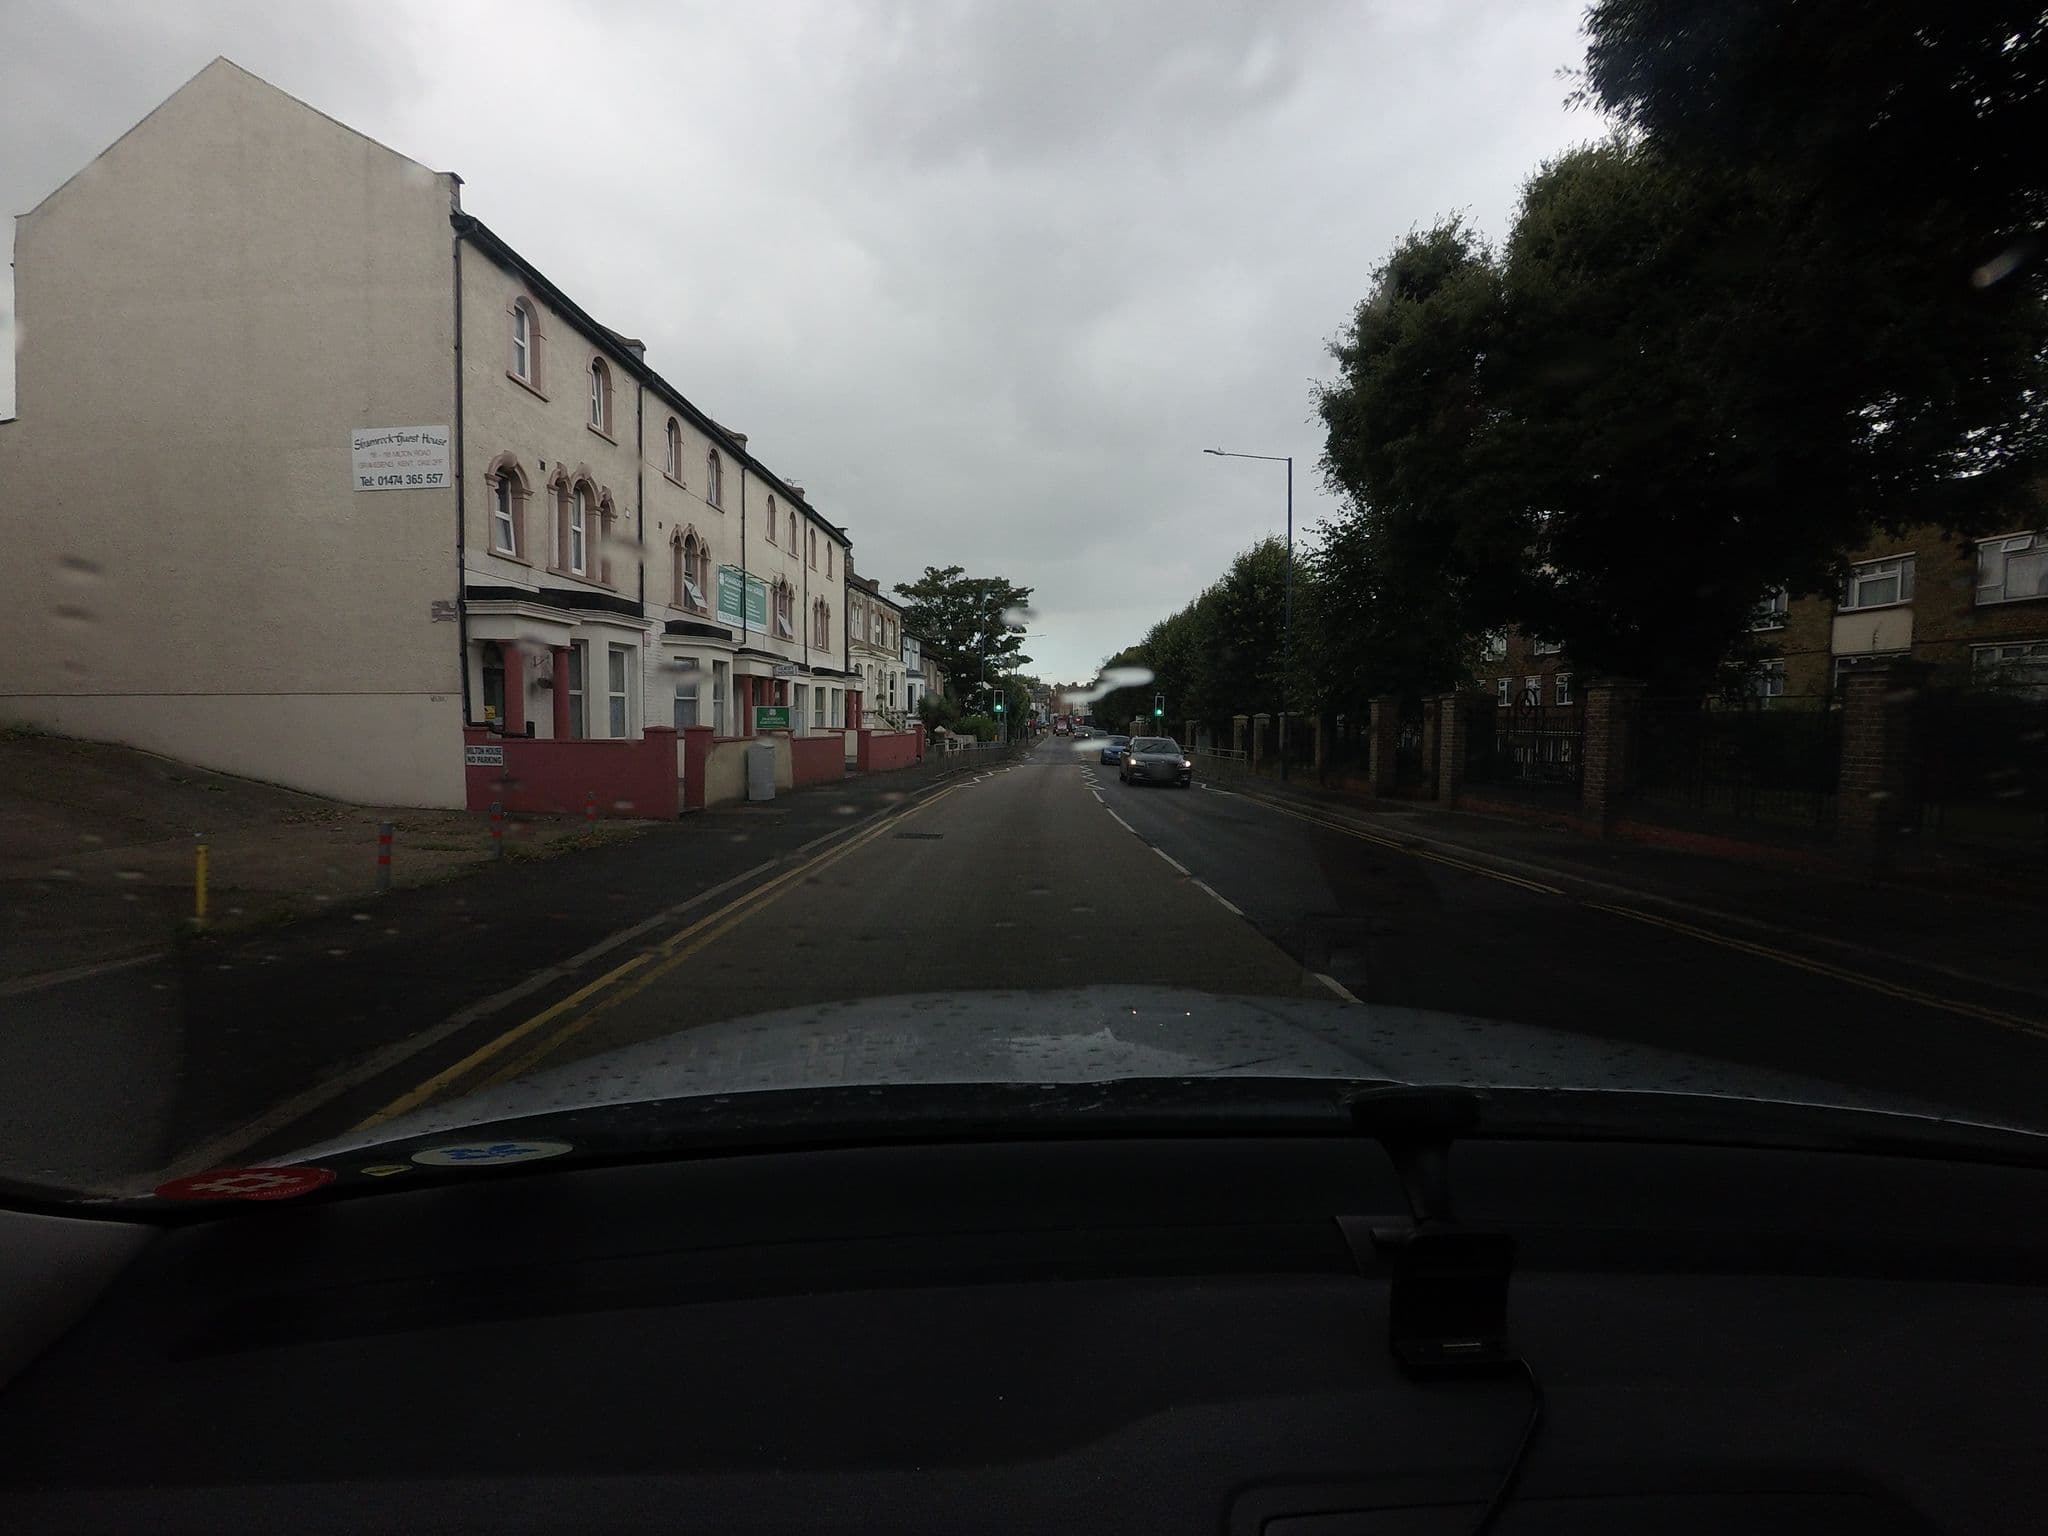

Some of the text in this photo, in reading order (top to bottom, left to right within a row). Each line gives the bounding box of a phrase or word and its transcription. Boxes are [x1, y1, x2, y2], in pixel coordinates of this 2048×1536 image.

[354, 432, 447, 450] Shamrock Guest House
[377, 475, 403, 486] 01474
[406, 474, 423, 485] 365
[426, 473, 443, 484] 557
[486, 747, 502, 755] HOUSE
[467, 756, 502, 764] NO PARKING
